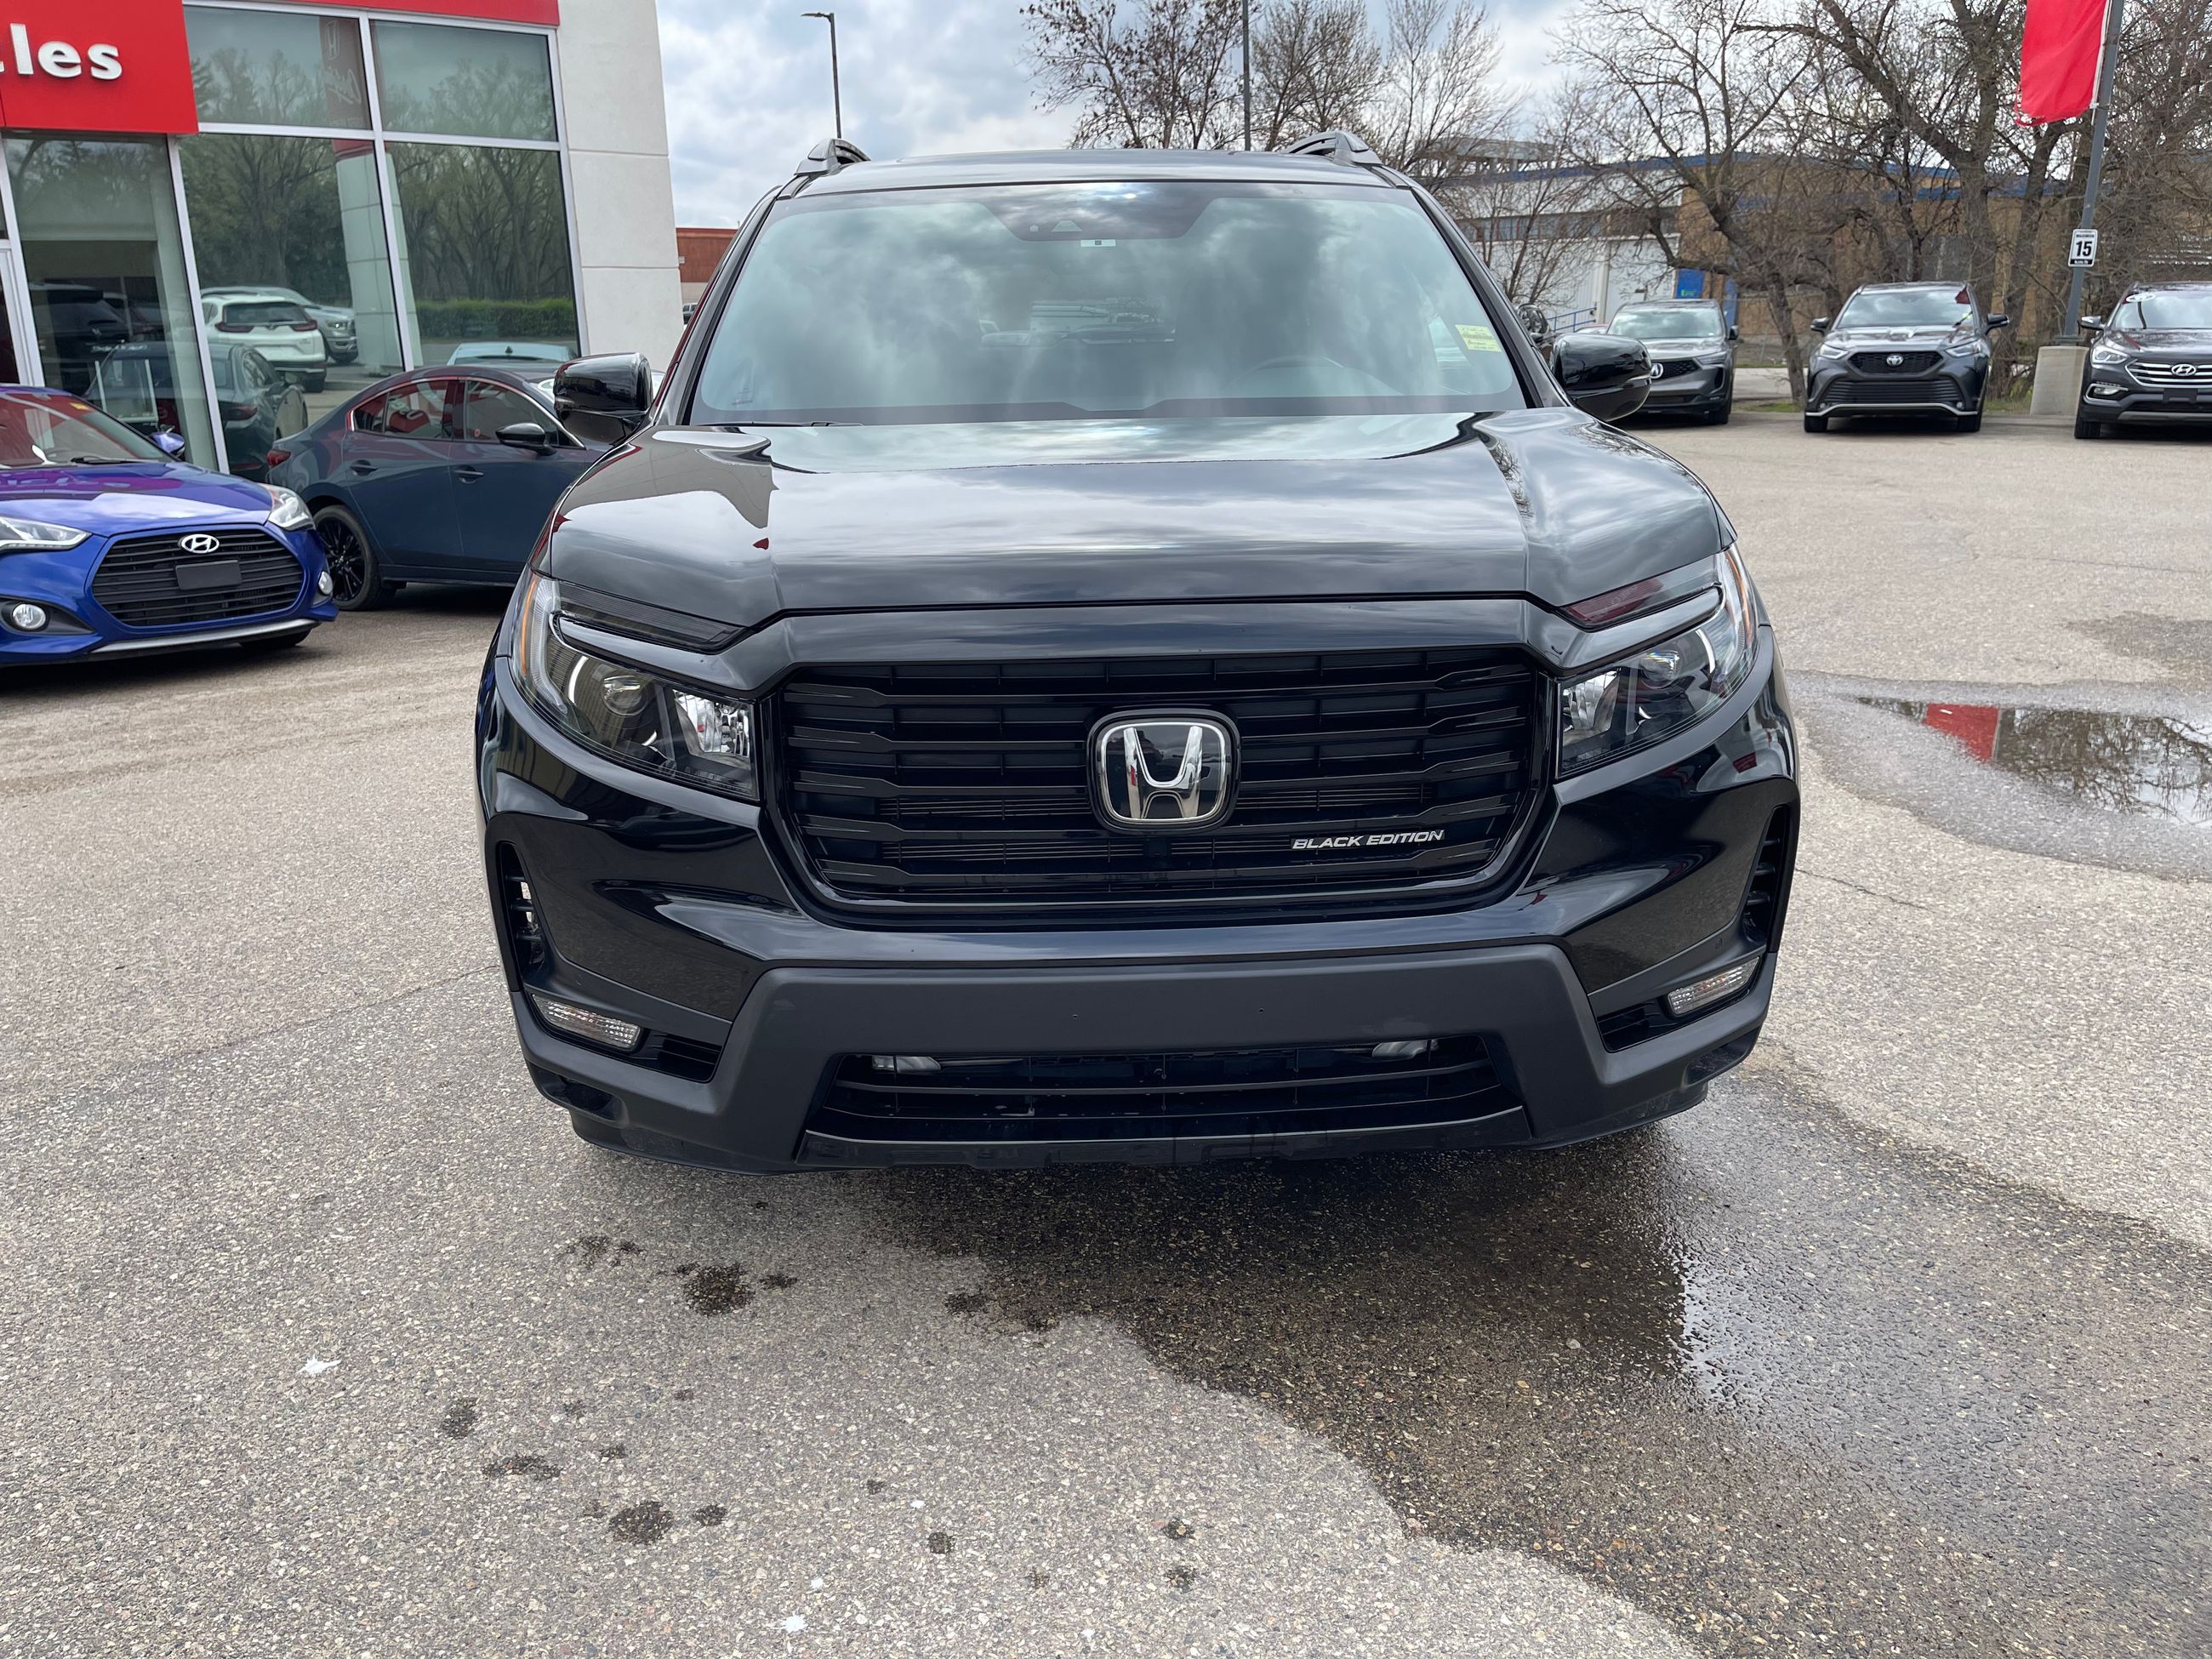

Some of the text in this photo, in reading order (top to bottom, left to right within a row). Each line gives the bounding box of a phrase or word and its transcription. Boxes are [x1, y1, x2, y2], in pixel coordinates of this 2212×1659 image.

[0, 23, 123, 80] les
[2075, 241, 2093, 257] 15
[1291, 830, 1445, 849] BLACK EDITION
